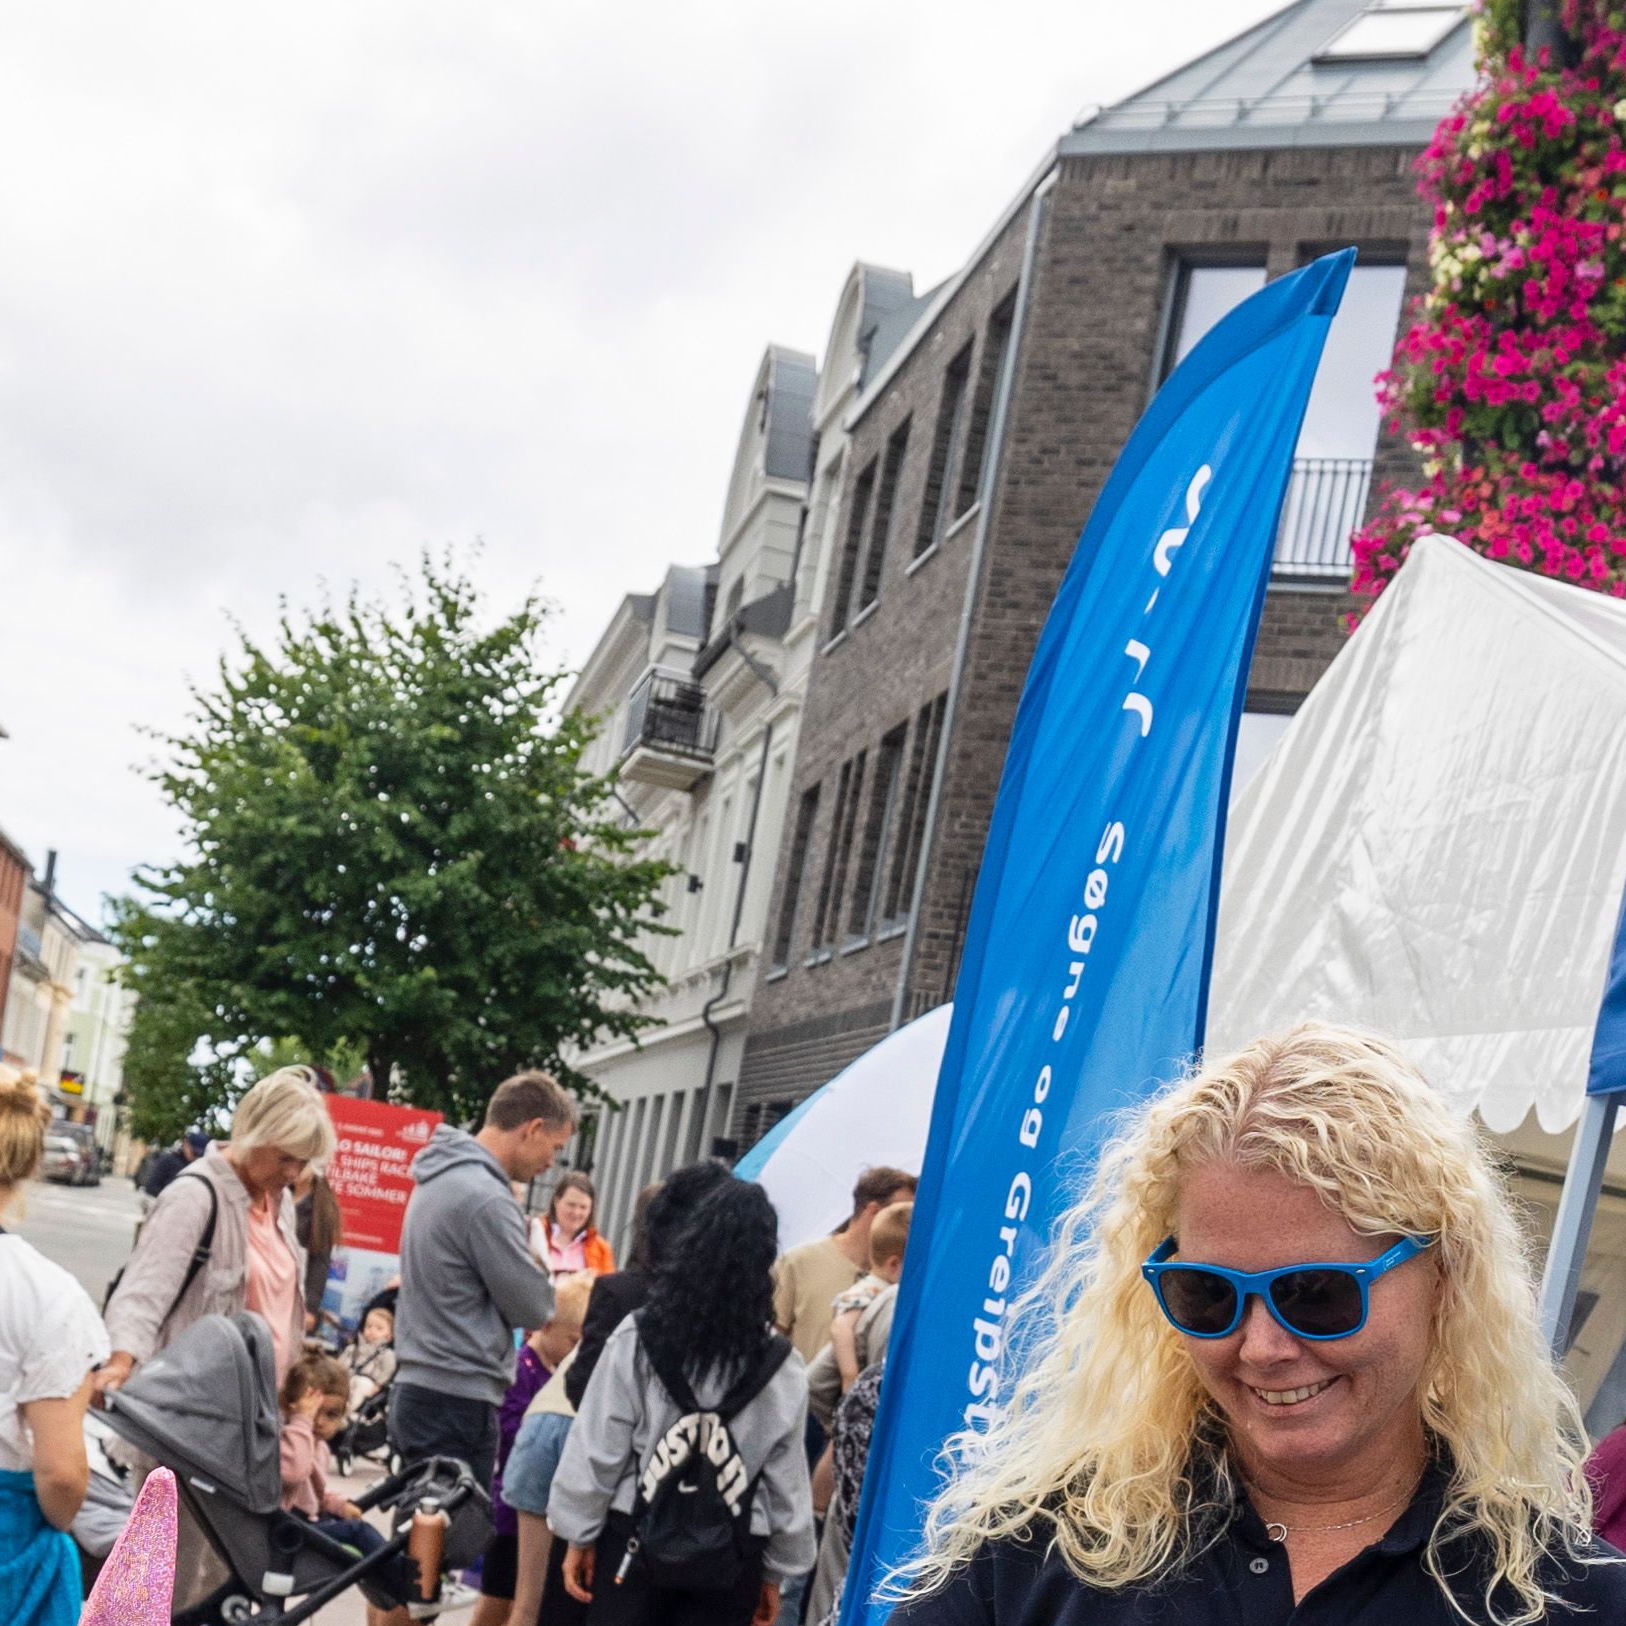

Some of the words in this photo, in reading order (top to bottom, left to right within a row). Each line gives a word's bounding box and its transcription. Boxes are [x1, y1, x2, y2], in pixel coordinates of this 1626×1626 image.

[1053, 820, 1125, 1044] Søgne
[1019, 1064, 1052, 1150] og
[963, 1171, 1032, 1436] Greipst
[641, 1412, 701, 1504] JUST
[699, 1412, 730, 1467] DO
